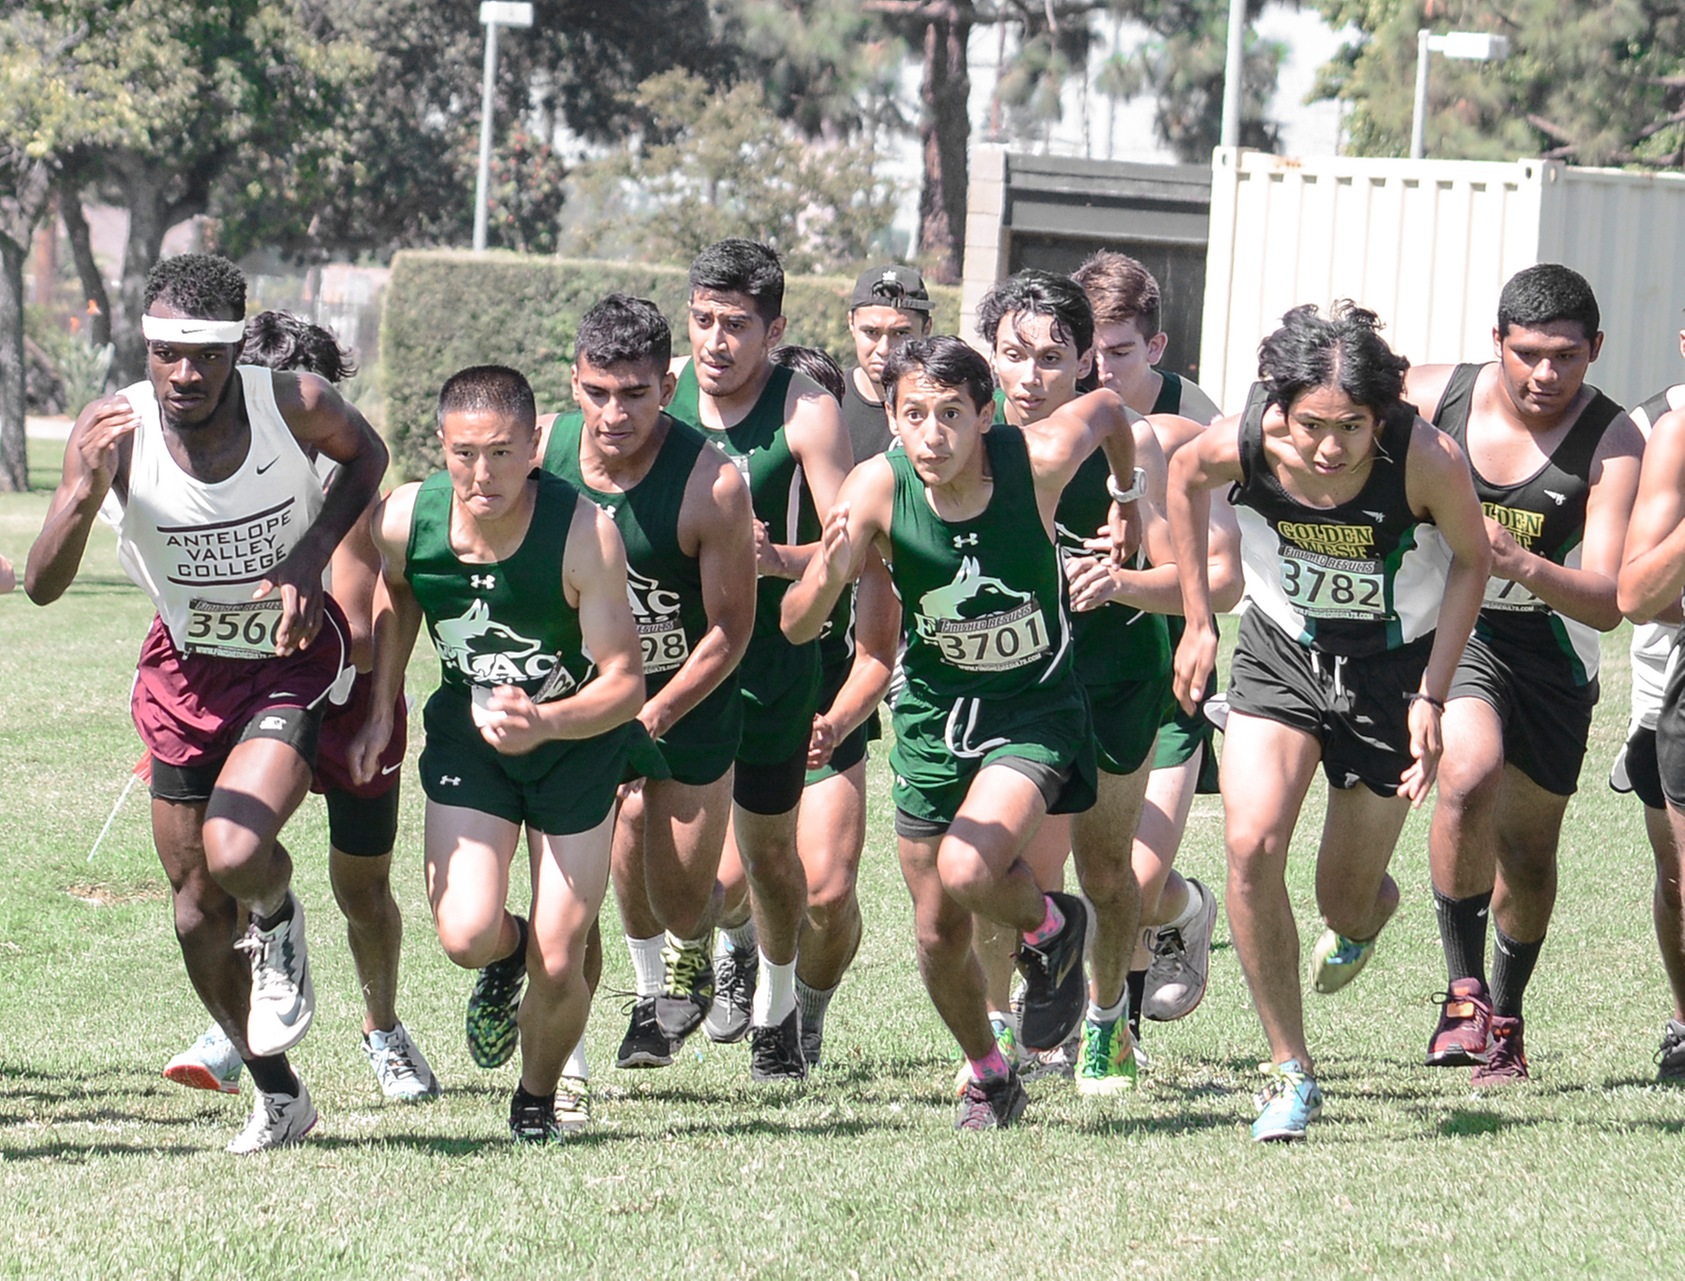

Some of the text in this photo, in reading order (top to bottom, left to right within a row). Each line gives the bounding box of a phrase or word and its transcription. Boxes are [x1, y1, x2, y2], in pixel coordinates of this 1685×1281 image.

[166, 509, 293, 547] ANTELOPE
[1278, 521, 1375, 546] GOLDEN
[1481, 502, 1545, 537] LDEN
[177, 544, 288, 577] COLLEGE
[186, 535, 277, 562] VALLEY
[1281, 559, 1380, 608] 3782
[640, 632, 685, 663] 98
[941, 617, 1040, 661] 3701
